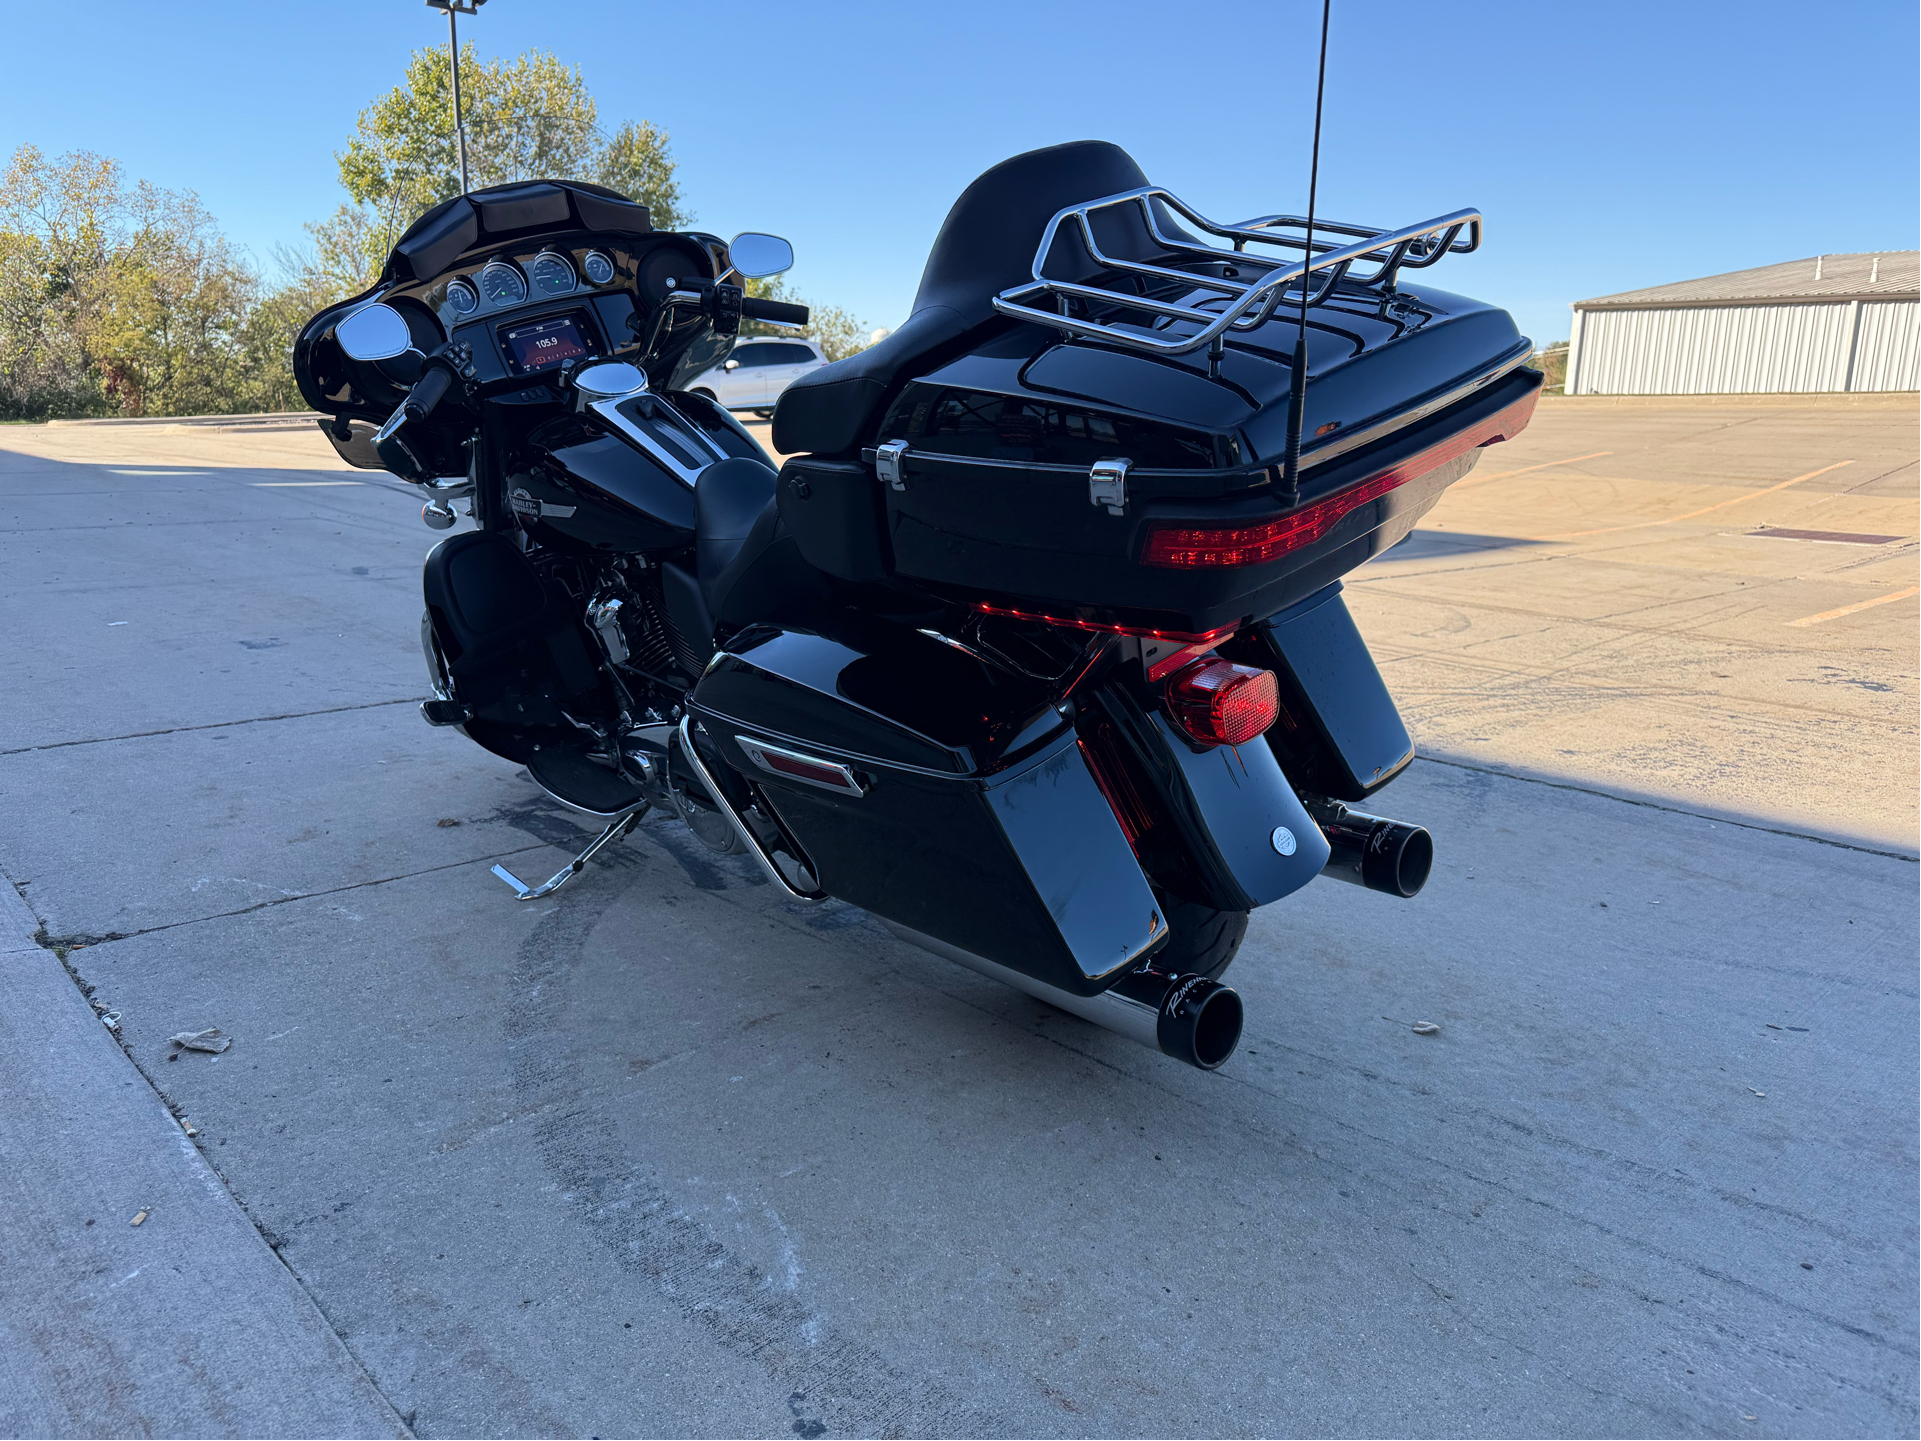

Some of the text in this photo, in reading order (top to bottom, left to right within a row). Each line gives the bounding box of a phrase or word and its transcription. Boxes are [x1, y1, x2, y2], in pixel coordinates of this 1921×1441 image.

[536, 337, 558, 349] 105.9
[1370, 821, 1399, 854] RINE
[1165, 976, 1208, 1019] RINEH
